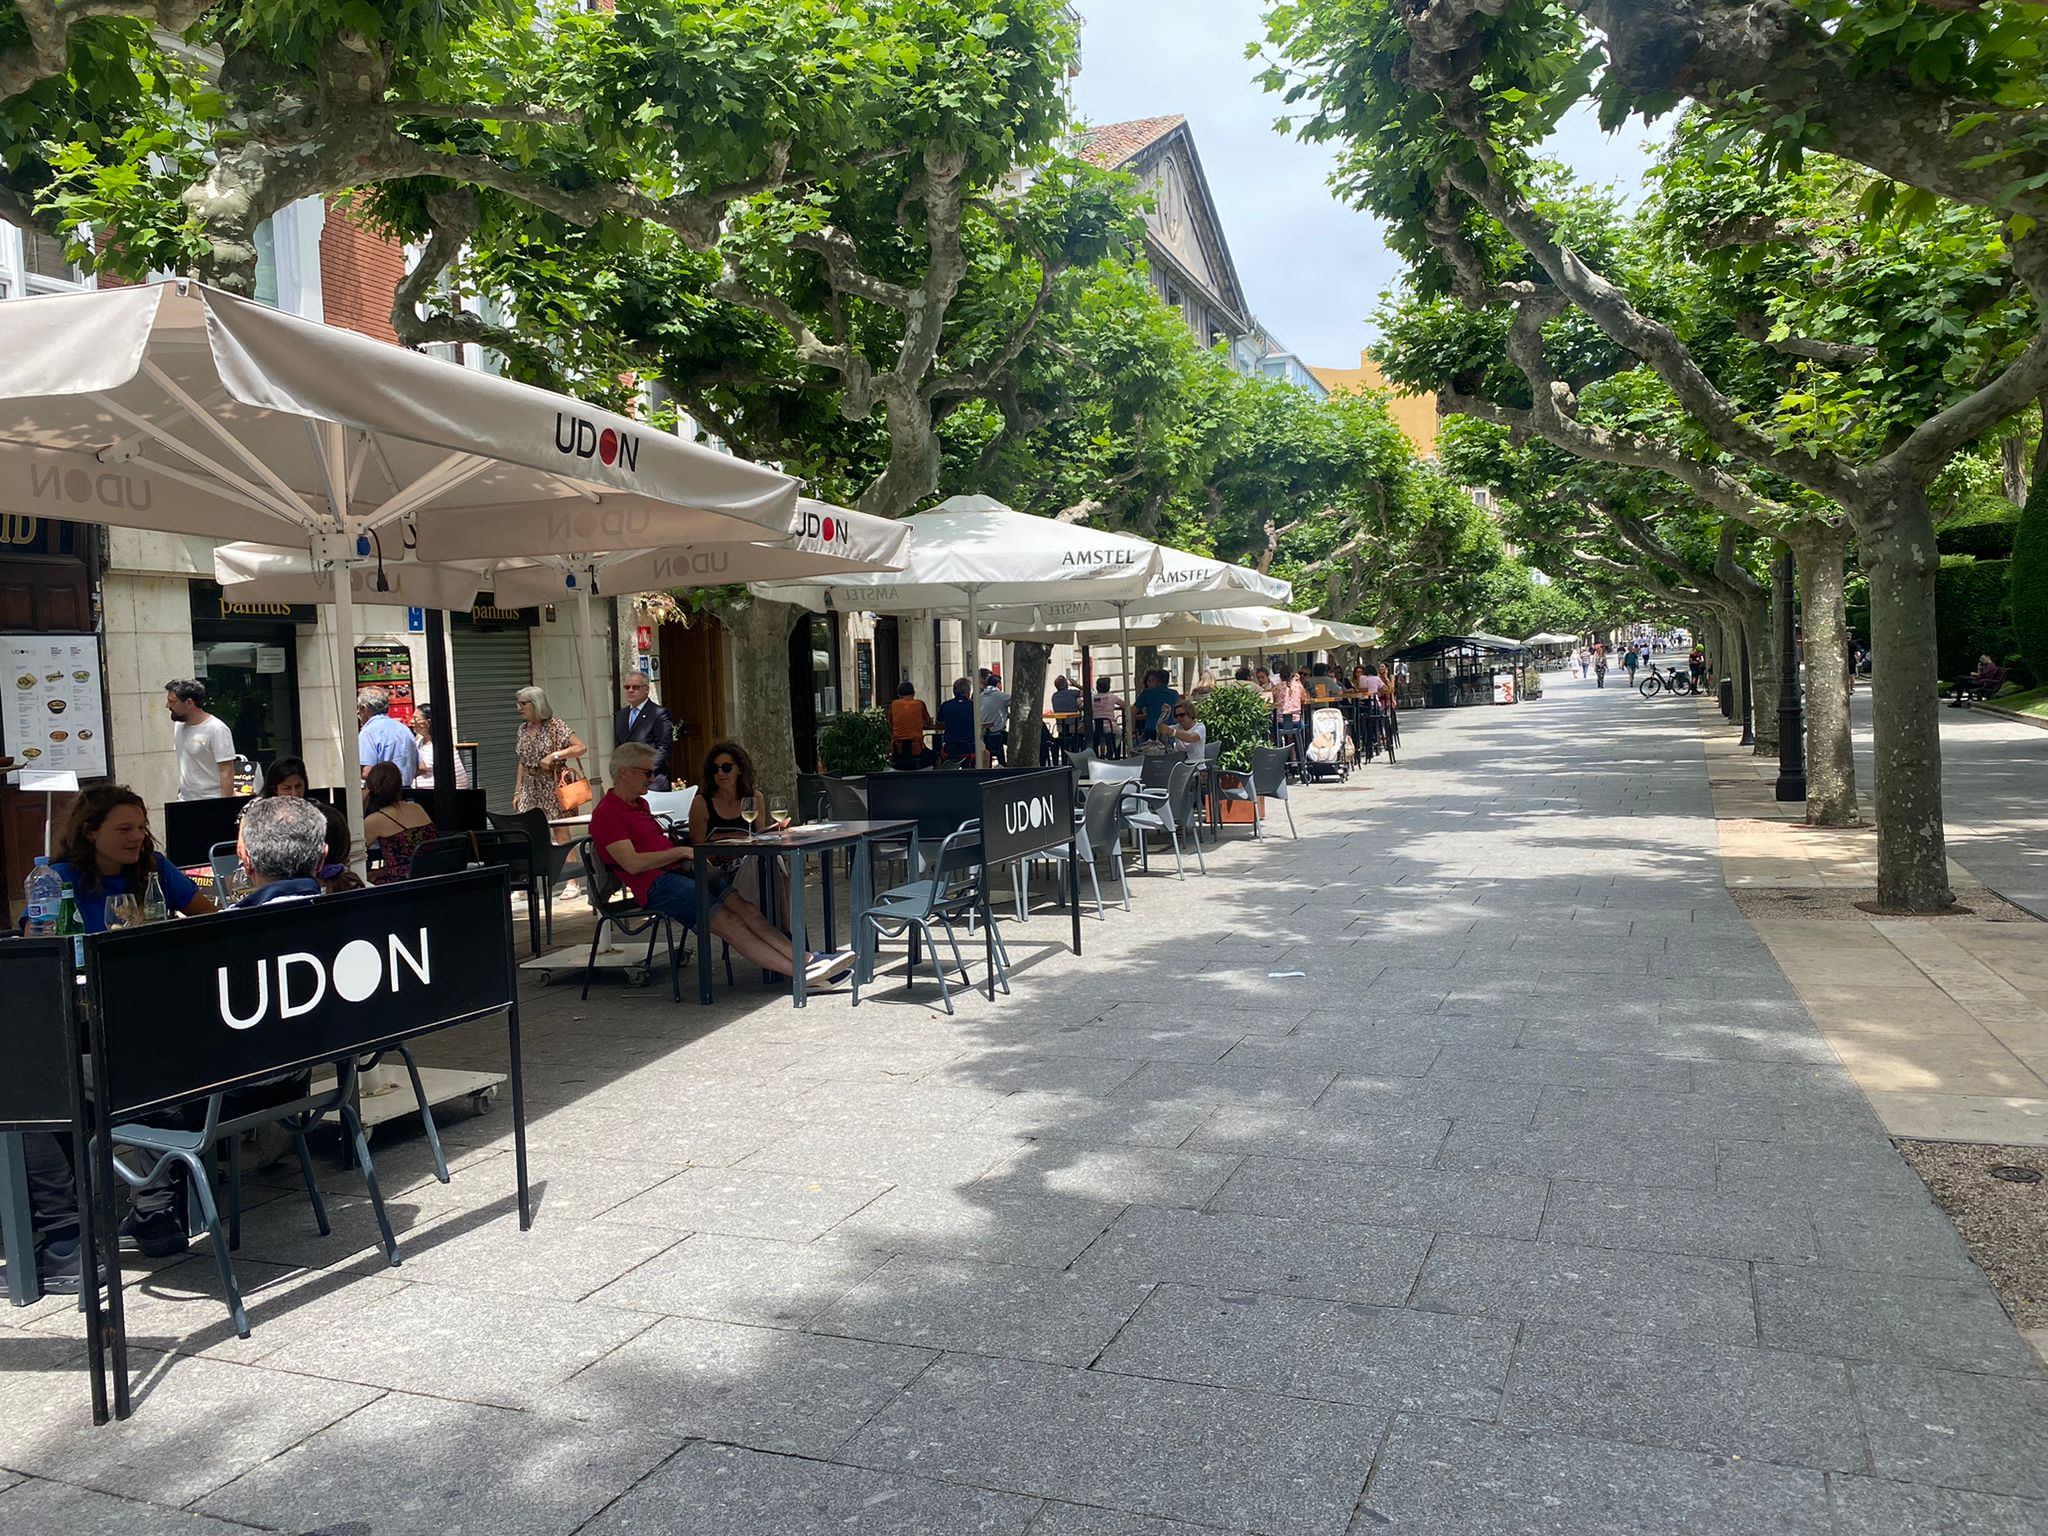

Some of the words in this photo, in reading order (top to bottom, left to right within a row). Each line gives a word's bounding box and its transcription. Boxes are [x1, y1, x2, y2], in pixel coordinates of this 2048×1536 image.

[555, 412, 639, 472] UDON
[1062, 550, 1135, 565] AMSTEL
[1156, 569, 1210, 583] AMSTEL
[1005, 794, 1054, 834] UDON
[218, 927, 431, 1030] UDON
